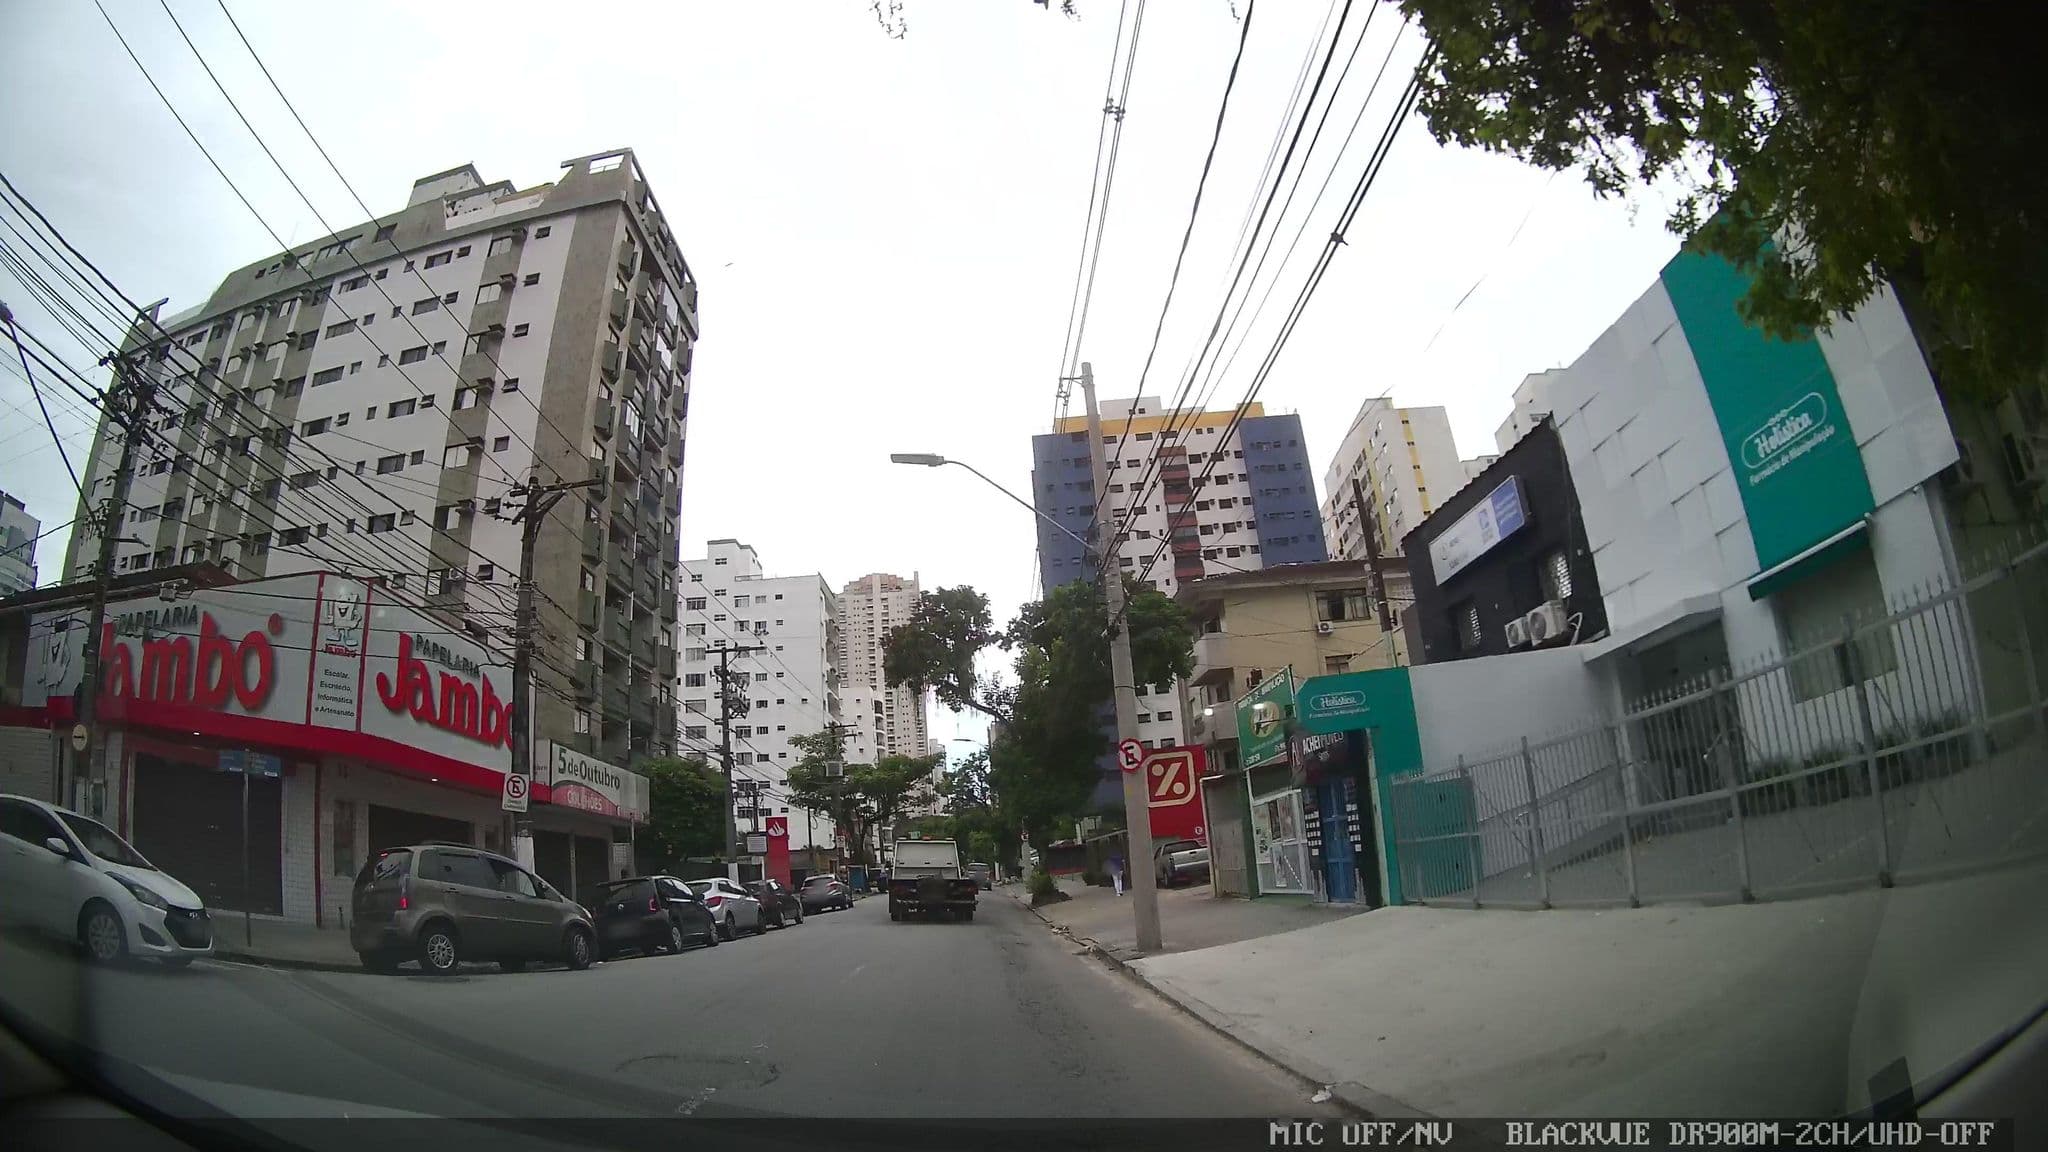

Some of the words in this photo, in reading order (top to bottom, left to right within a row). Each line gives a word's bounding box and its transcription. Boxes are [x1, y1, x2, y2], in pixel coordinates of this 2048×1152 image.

[415, 633, 480, 678] PAPELARIA
[558, 748, 568, 775] 5
[567, 757, 579, 777] de
[579, 759, 621, 790] Outubro
